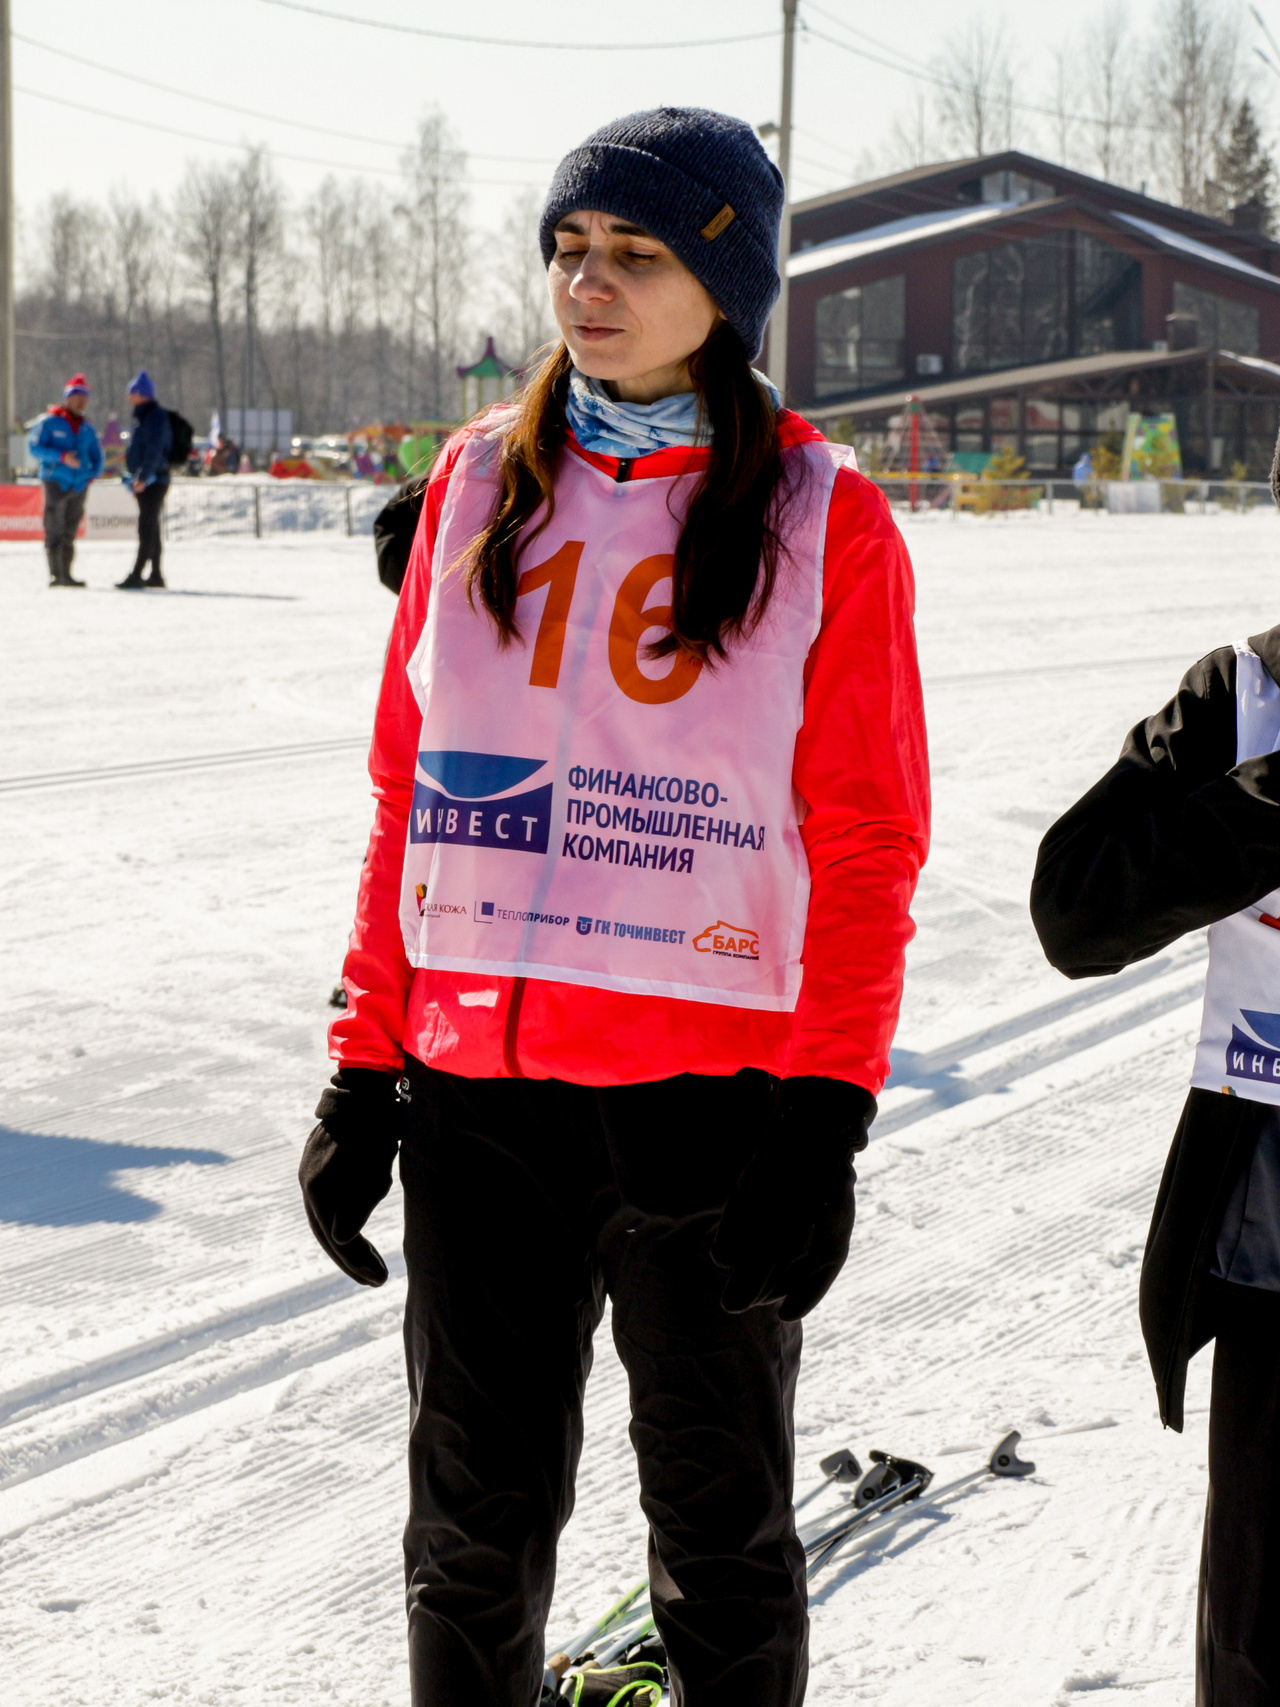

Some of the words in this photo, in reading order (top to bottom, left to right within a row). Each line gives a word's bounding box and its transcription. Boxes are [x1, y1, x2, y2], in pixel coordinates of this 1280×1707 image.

[516, 540, 704, 705] 16
[568, 765, 728, 808] ФИНАНСОВО-
[566, 798, 766, 851] ПРОМЫШЛЕННАЯ
[561, 832, 695, 874] КОМПАНИЯ
[439, 904, 467, 915] КОЖА
[497, 908, 570, 926] ТЕПЛОПРИБОР
[594, 919, 611, 935] ГК
[613, 922, 686, 945] ТОЧИНВЕСТ
[713, 934, 760, 955] БАРС
